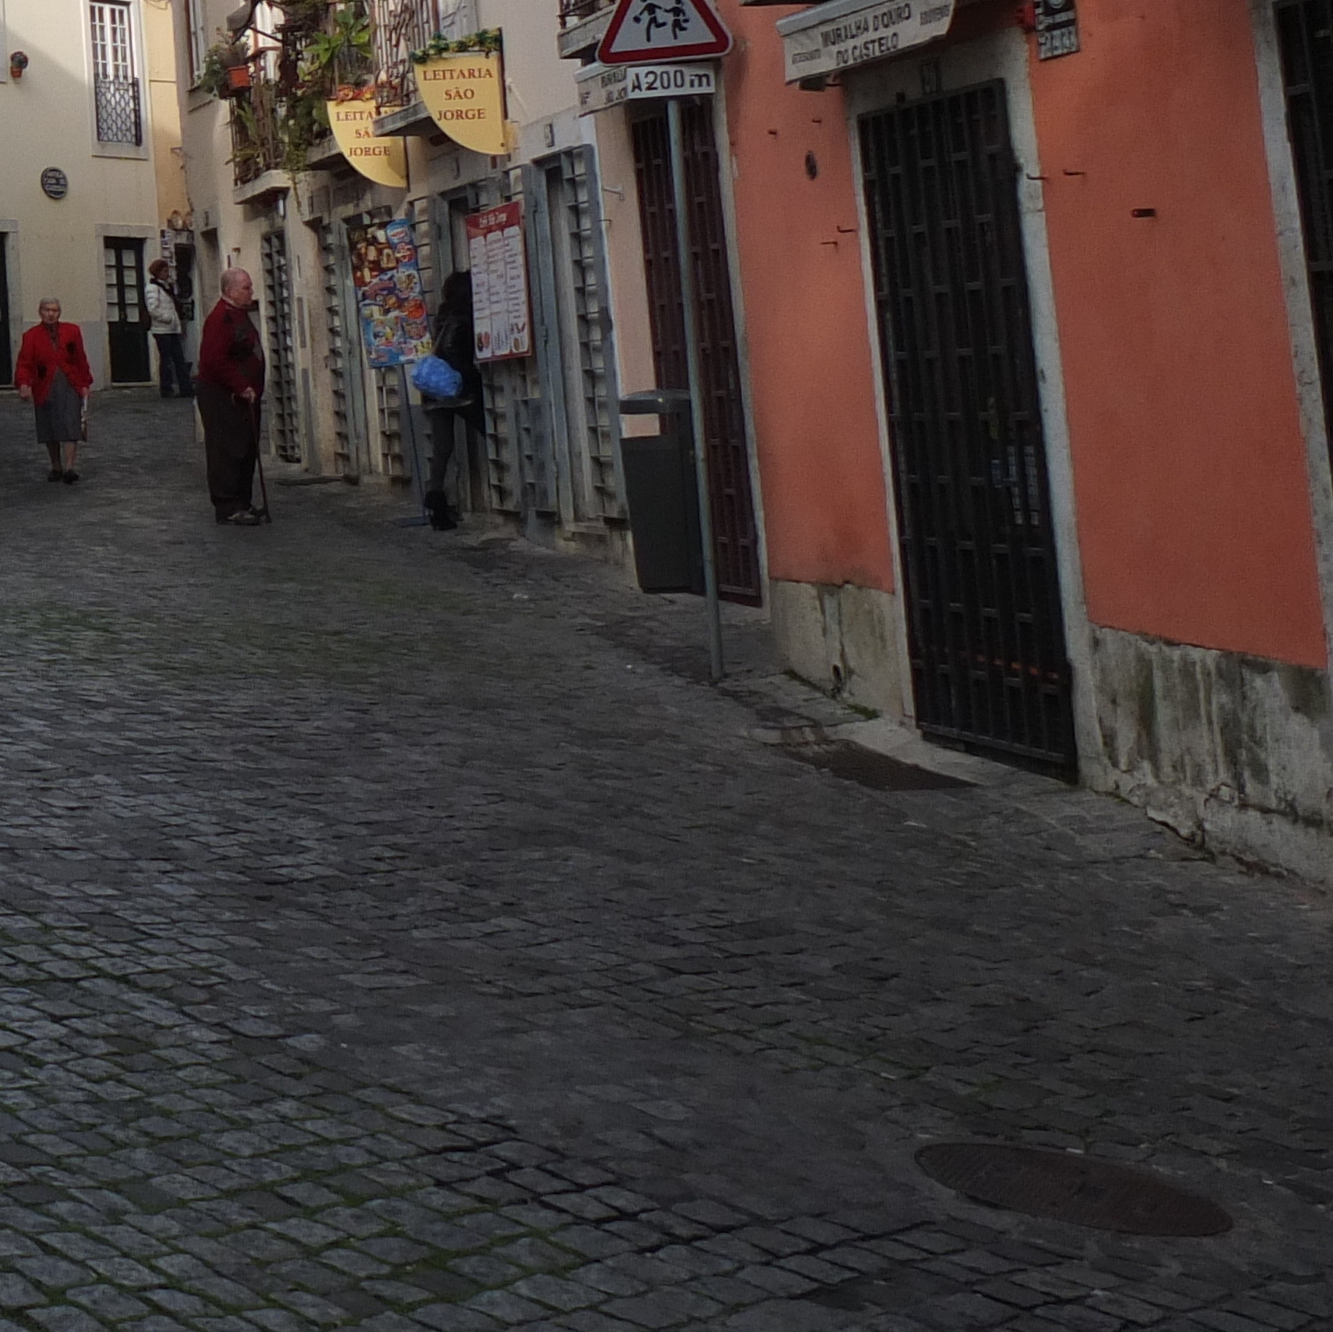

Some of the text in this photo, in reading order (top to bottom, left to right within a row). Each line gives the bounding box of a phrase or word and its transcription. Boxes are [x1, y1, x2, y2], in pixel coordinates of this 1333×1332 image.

[821, 20, 869, 47] MURALHA
[836, 32, 899, 66] DO CASTELO
[423, 68, 493, 81] LEITARIA
[444, 87, 475, 101] SÃO
[437, 108, 486, 121] JORGE
[355, 127, 374, 139] SÃ
[349, 146, 391, 157] JORGE
